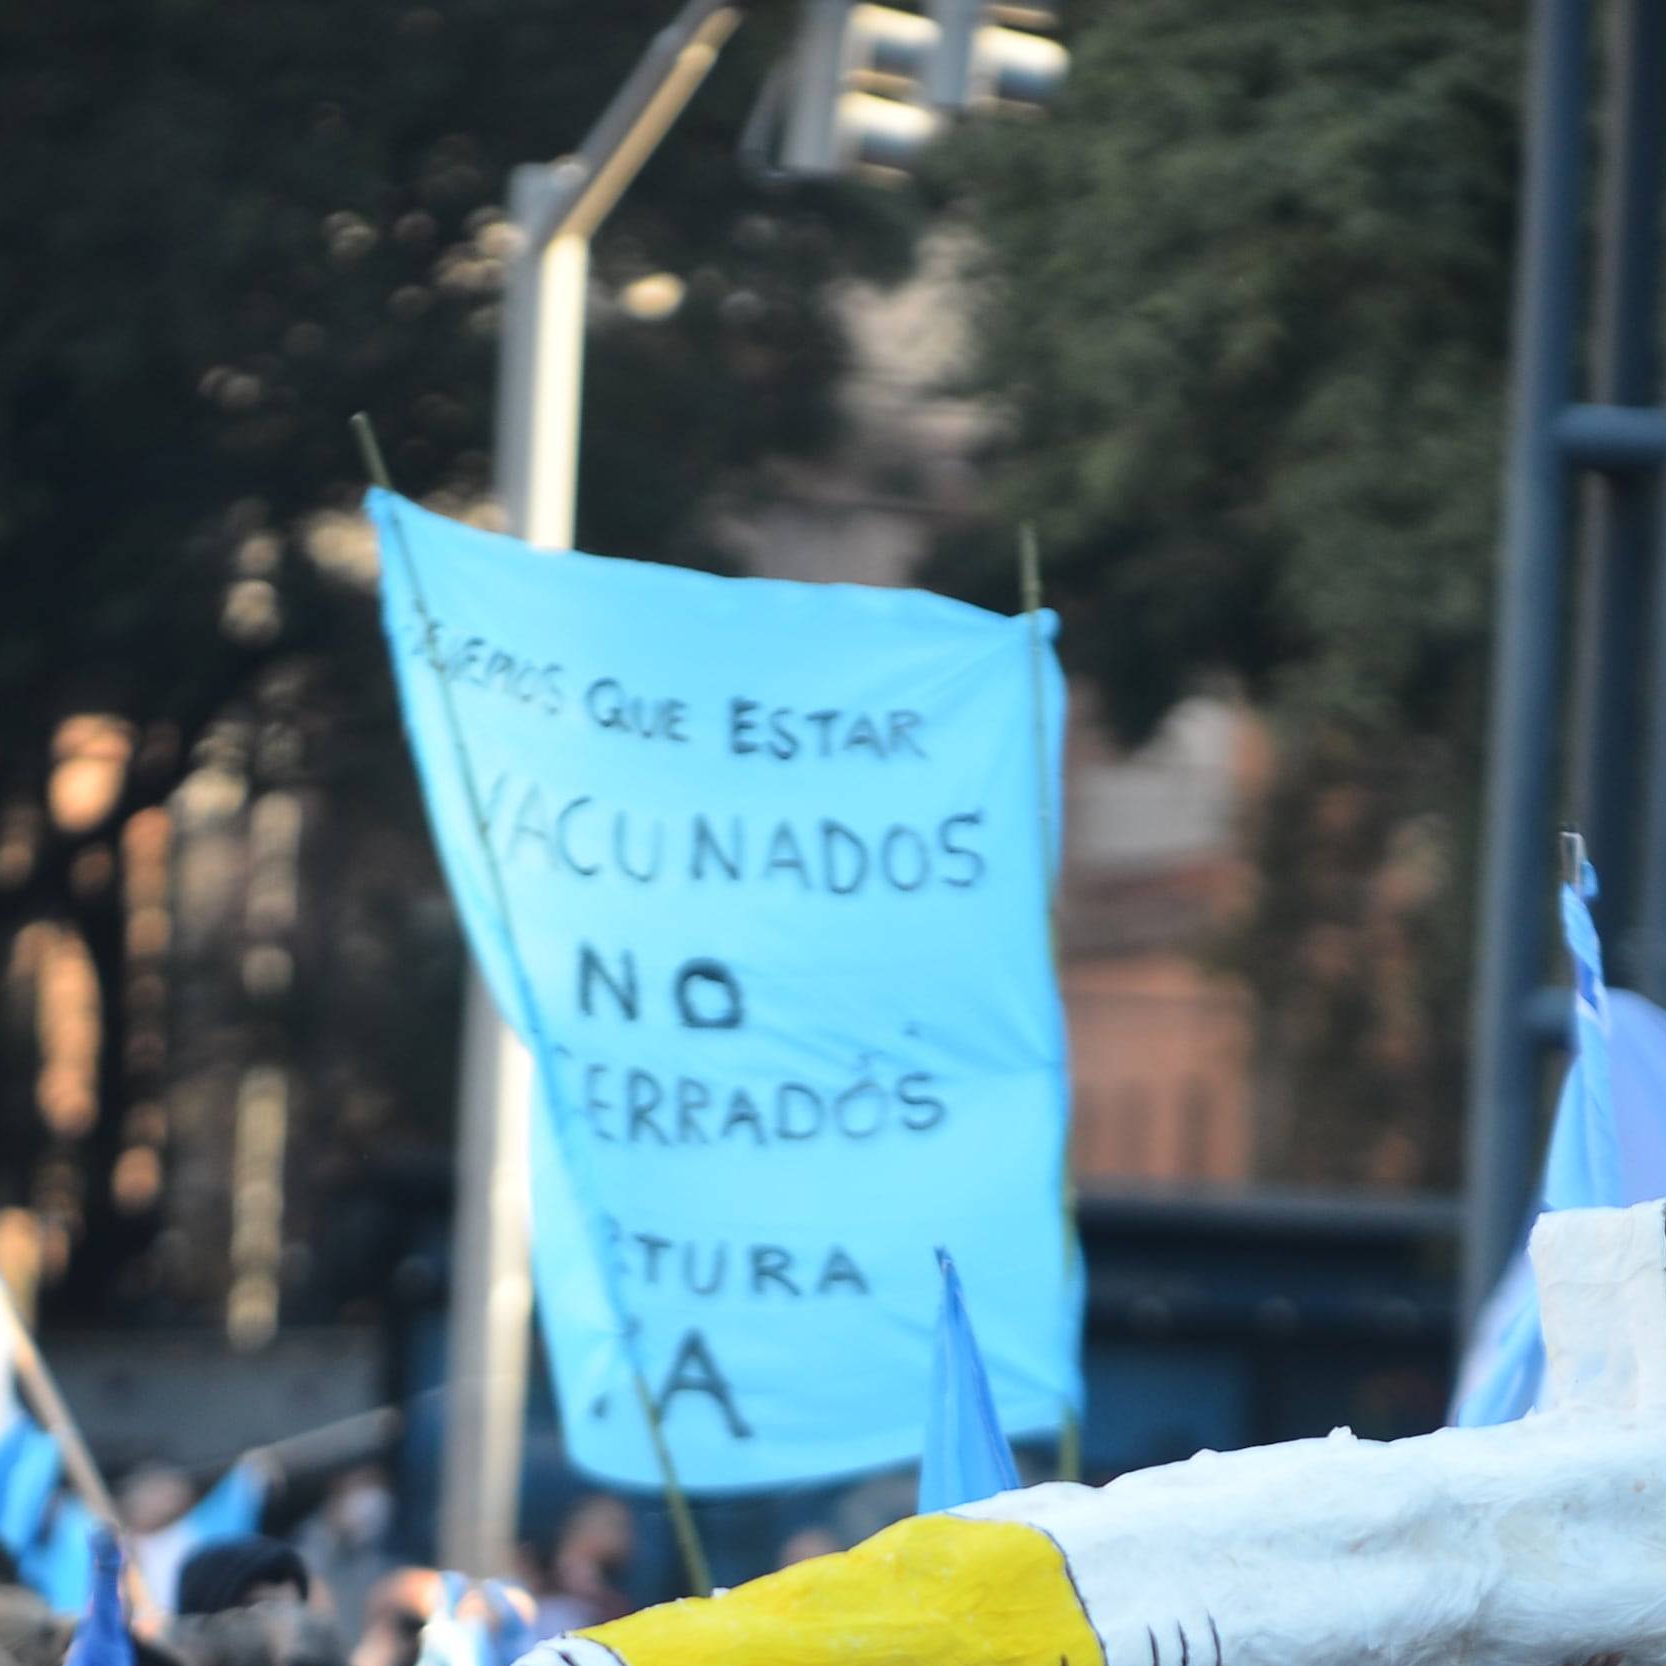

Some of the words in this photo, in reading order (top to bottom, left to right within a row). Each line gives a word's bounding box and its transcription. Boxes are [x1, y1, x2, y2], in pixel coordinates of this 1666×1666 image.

[585, 678, 692, 744] QUE
[730, 697, 931, 761] ESTAR
[481, 770, 987, 895] VACUNADOS
[577, 938, 747, 1031] NO
[551, 1044, 949, 1147] ERRADOS
